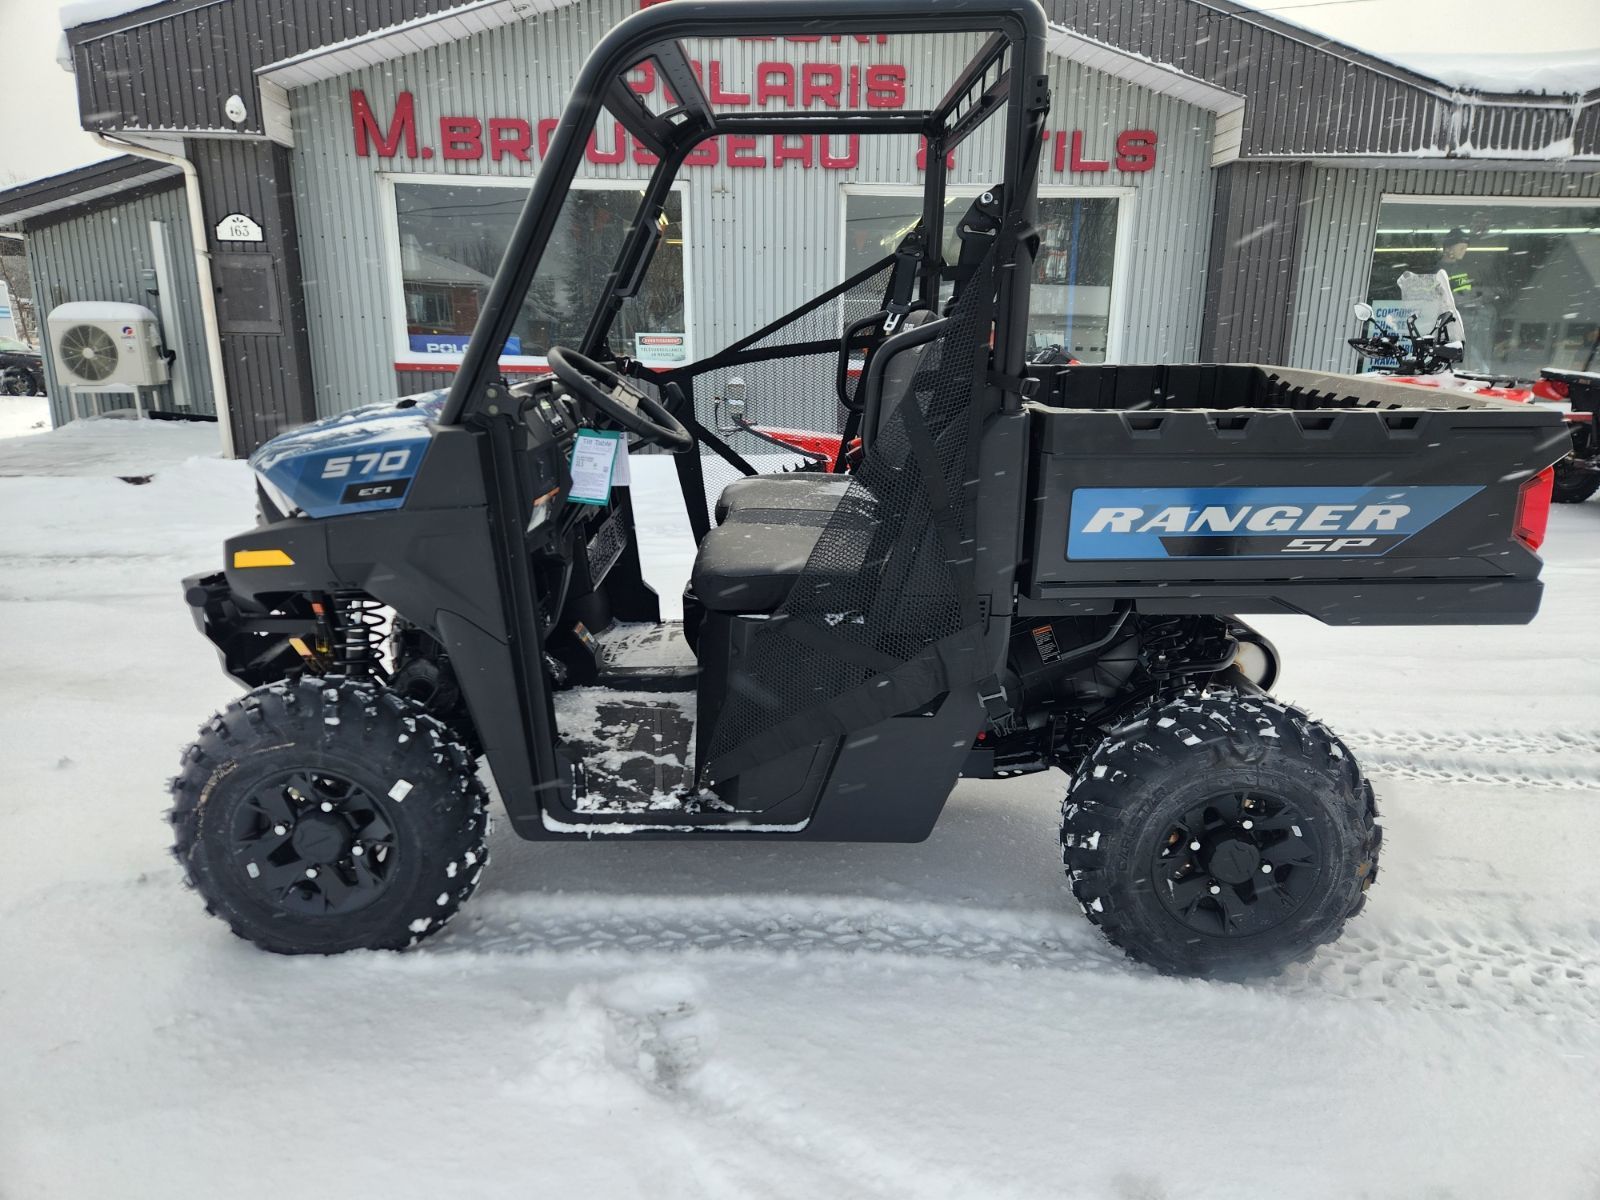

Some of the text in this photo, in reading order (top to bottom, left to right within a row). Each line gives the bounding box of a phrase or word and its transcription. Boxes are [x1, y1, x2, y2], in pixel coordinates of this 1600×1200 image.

[1043, 130, 1158, 173] ILS
[230, 225, 250, 237] 163
[321, 449, 411, 479] 570
[358, 485, 393, 497] EFI
[1081, 504, 1412, 533] RANGER
[1280, 537, 1378, 552] SP
